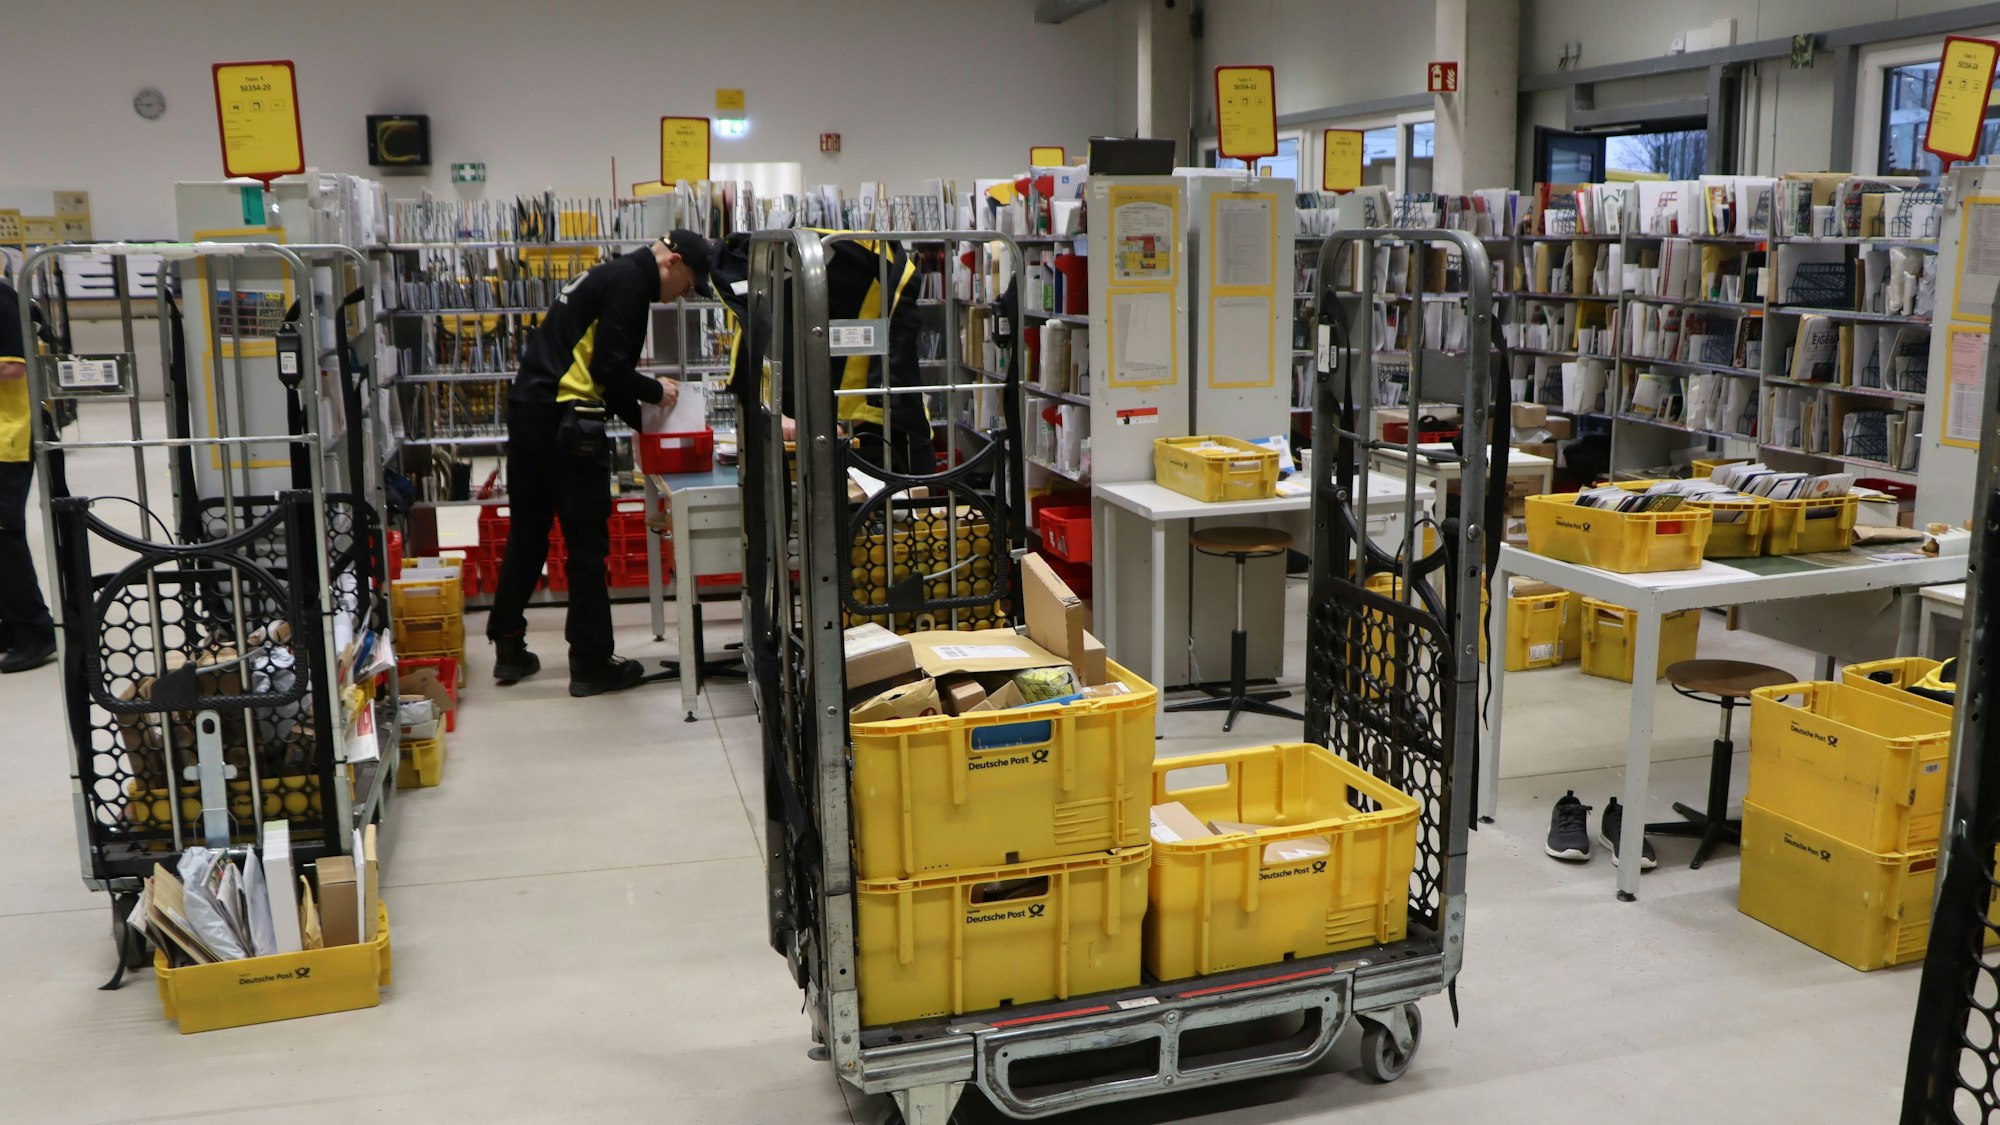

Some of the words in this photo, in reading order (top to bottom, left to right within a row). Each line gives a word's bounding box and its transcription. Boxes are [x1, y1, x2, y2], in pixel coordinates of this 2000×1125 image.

[240, 83, 272, 92] 50354-20
[1790, 725, 1814, 738] Deutsche
[1814, 733, 1826, 742] Post
[968, 759, 1009, 771] Deutsche
[1010, 756, 1029, 765] Post
[1784, 837, 1807, 851] Deutsche
[1807, 846, 1819, 856] Post
[1259, 870, 1292, 881] Deutsche
[1293, 867, 1310, 875] Post
[966, 913, 1006, 924] Deutsche
[1007, 910, 1026, 919] Post
[239, 975, 275, 985] Deutsche
[276, 972, 293, 980] Post
